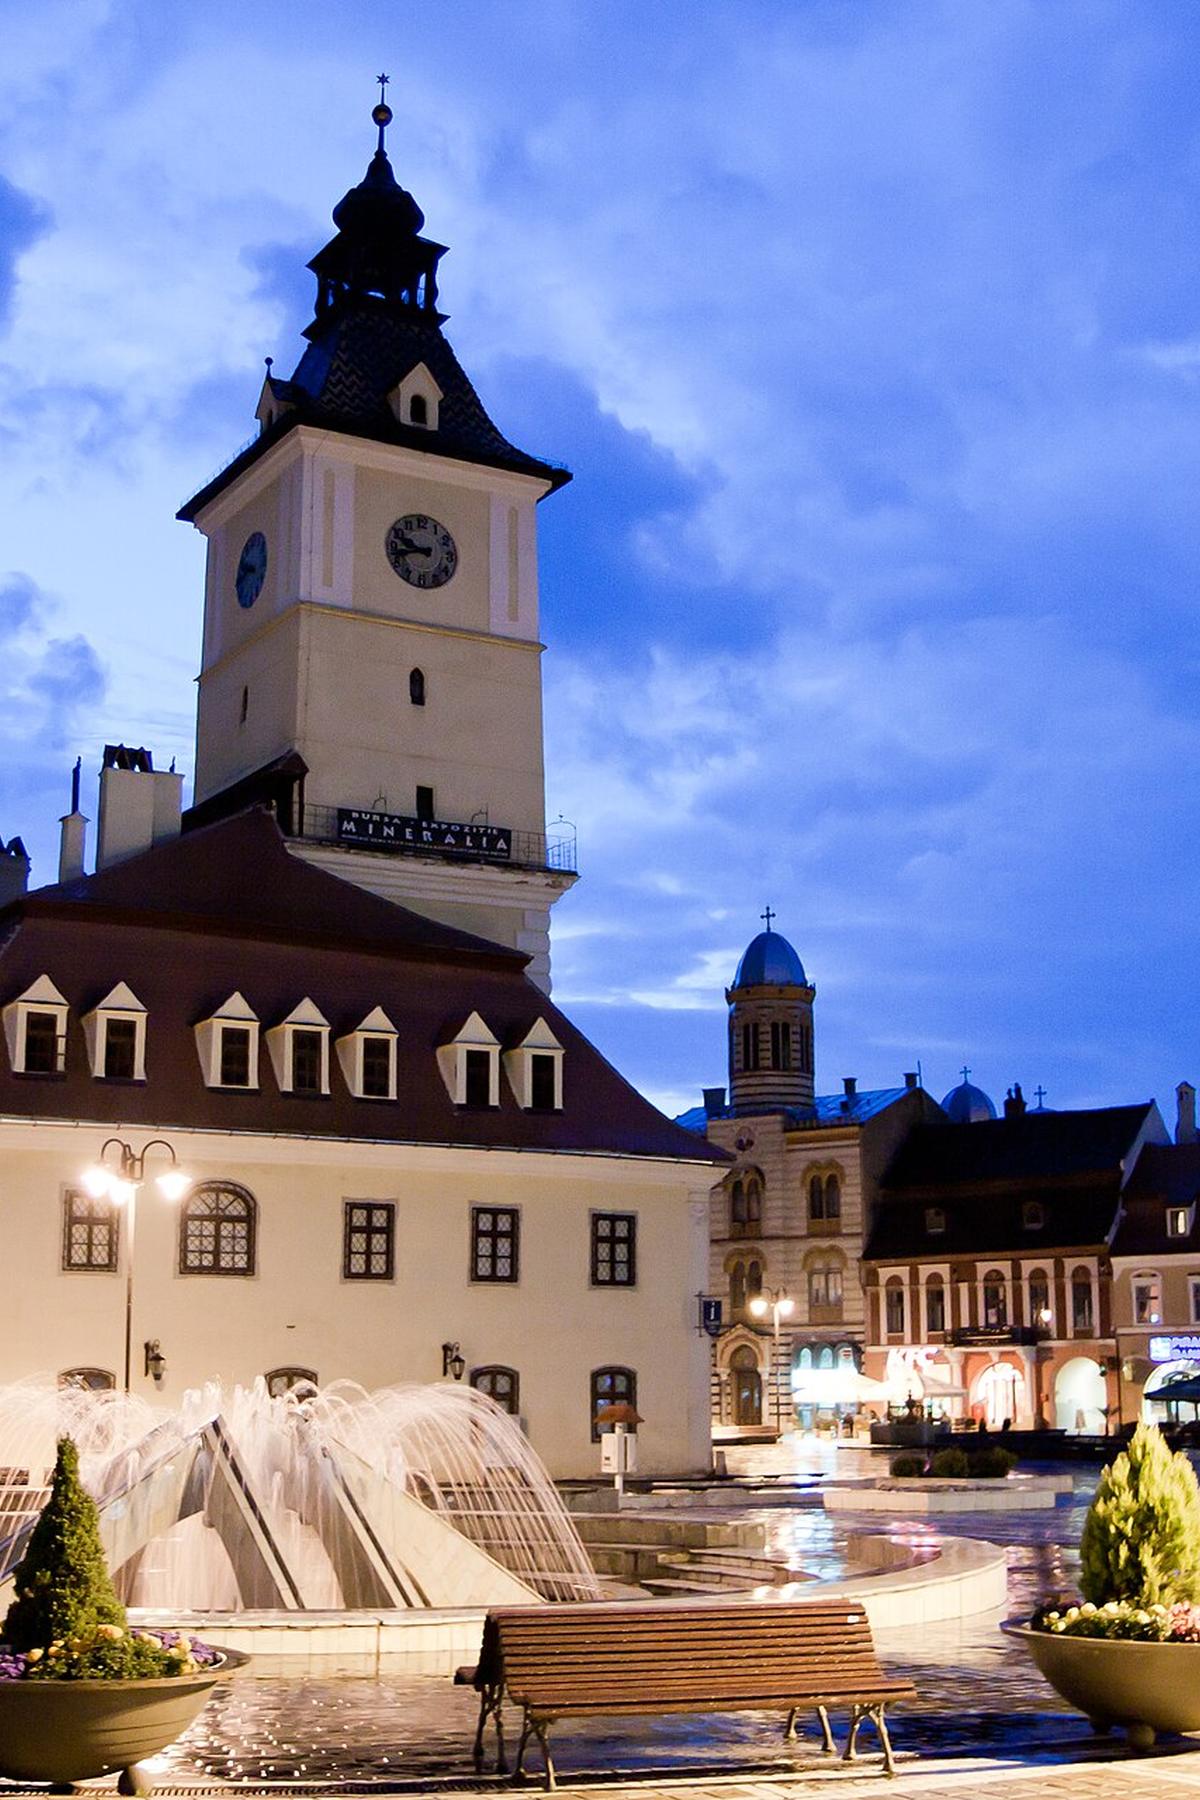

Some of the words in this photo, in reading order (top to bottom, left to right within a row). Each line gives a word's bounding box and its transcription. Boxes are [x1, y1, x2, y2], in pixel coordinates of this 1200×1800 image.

[404, 520, 413, 531] 11
[417, 517, 428, 530] 12
[433, 524, 438, 535] 1
[441, 535, 450, 547] 2
[446, 551, 454, 563] 3
[352, 812, 401, 825] BURSA
[342, 820, 508, 850] MINERALIA
[888, 1347, 938, 1369] KFC
